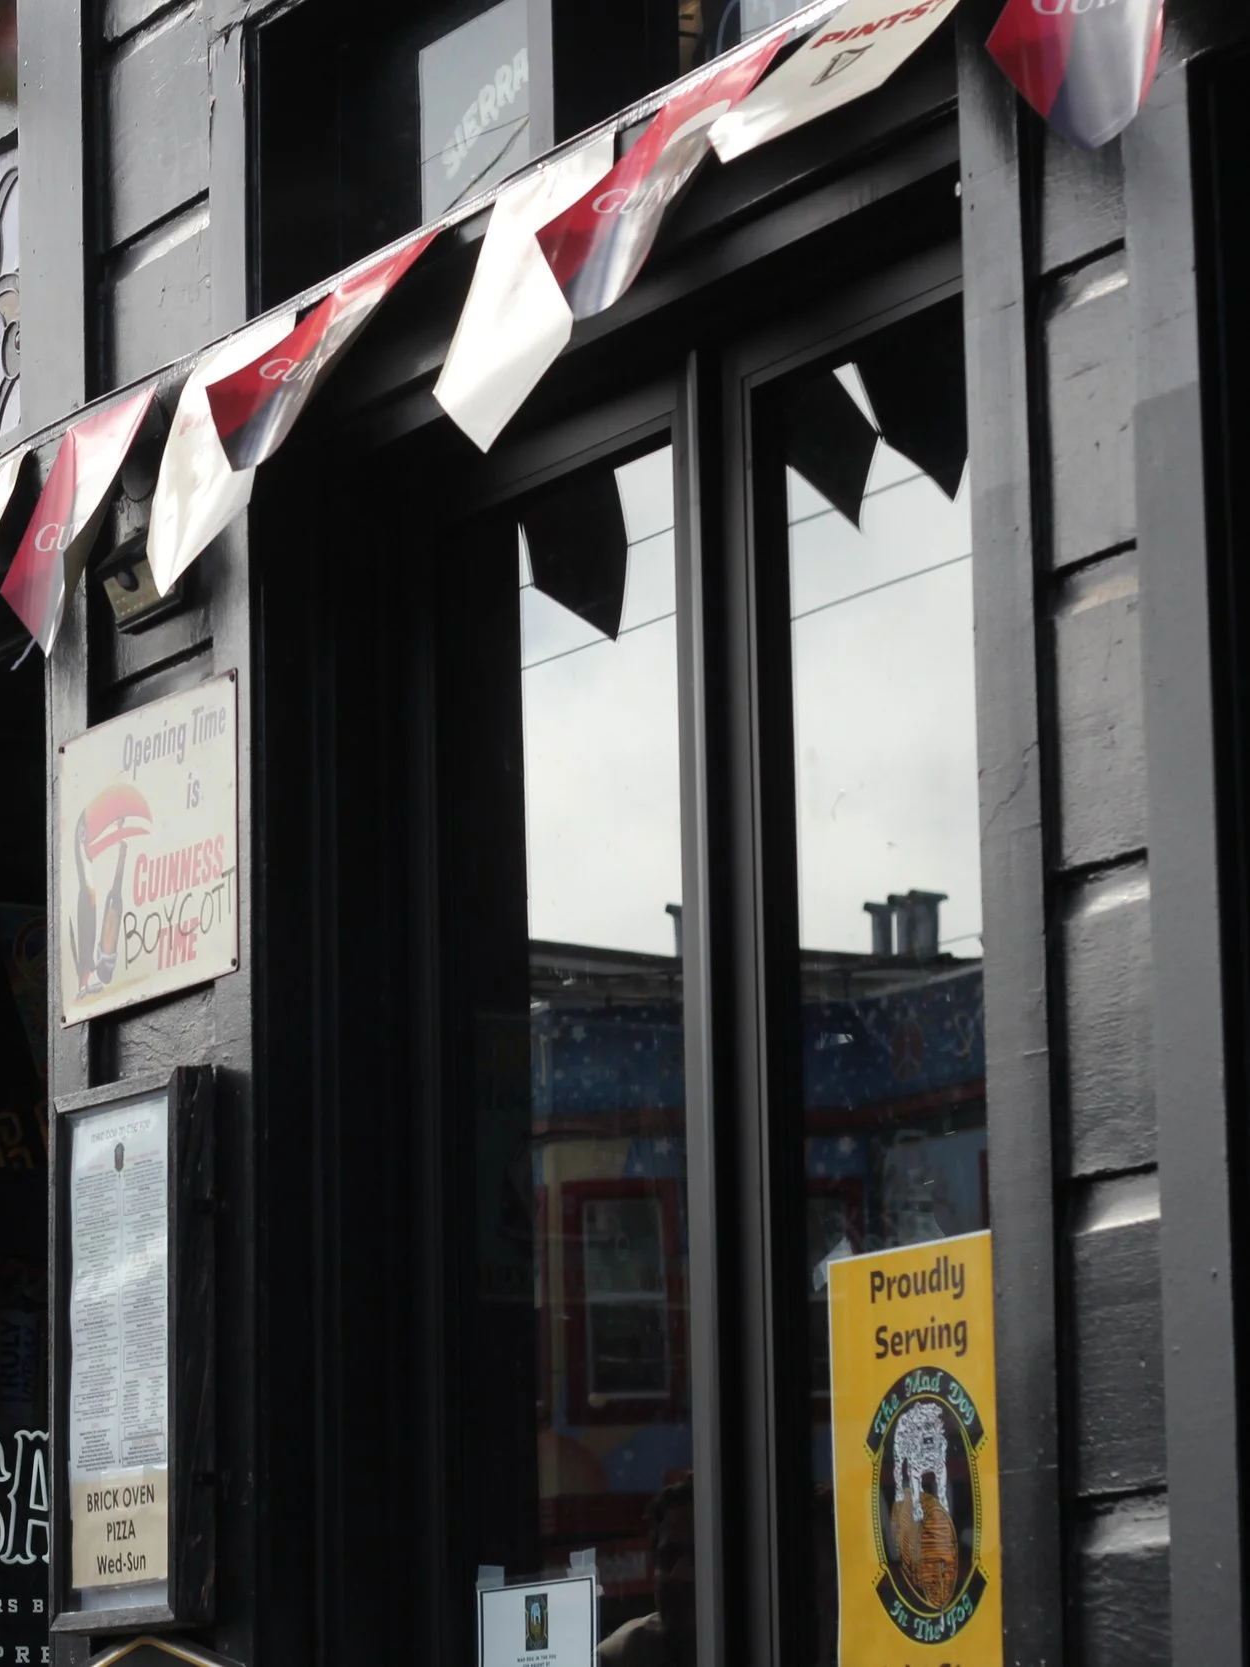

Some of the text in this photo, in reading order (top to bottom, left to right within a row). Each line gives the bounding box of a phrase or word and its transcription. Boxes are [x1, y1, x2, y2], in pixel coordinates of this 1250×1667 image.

[441, 47, 530, 181] SIERRA
[122, 705, 227, 780] Opening Time
[186, 773, 201, 810] is
[132, 832, 226, 908] GUINNESS
[121, 865, 237, 971] BOYCOTT
[156, 915, 201, 971] TIME
[869, 1255, 965, 1304] Proudly
[874, 1315, 968, 1360] Serving
[874, 1369, 976, 1435] The Mad Dog
[86, 1483, 155, 1513] BRICK OVEN
[106, 1519, 137, 1543] PIZZA
[96, 1551, 147, 1576] Wed-Sun
